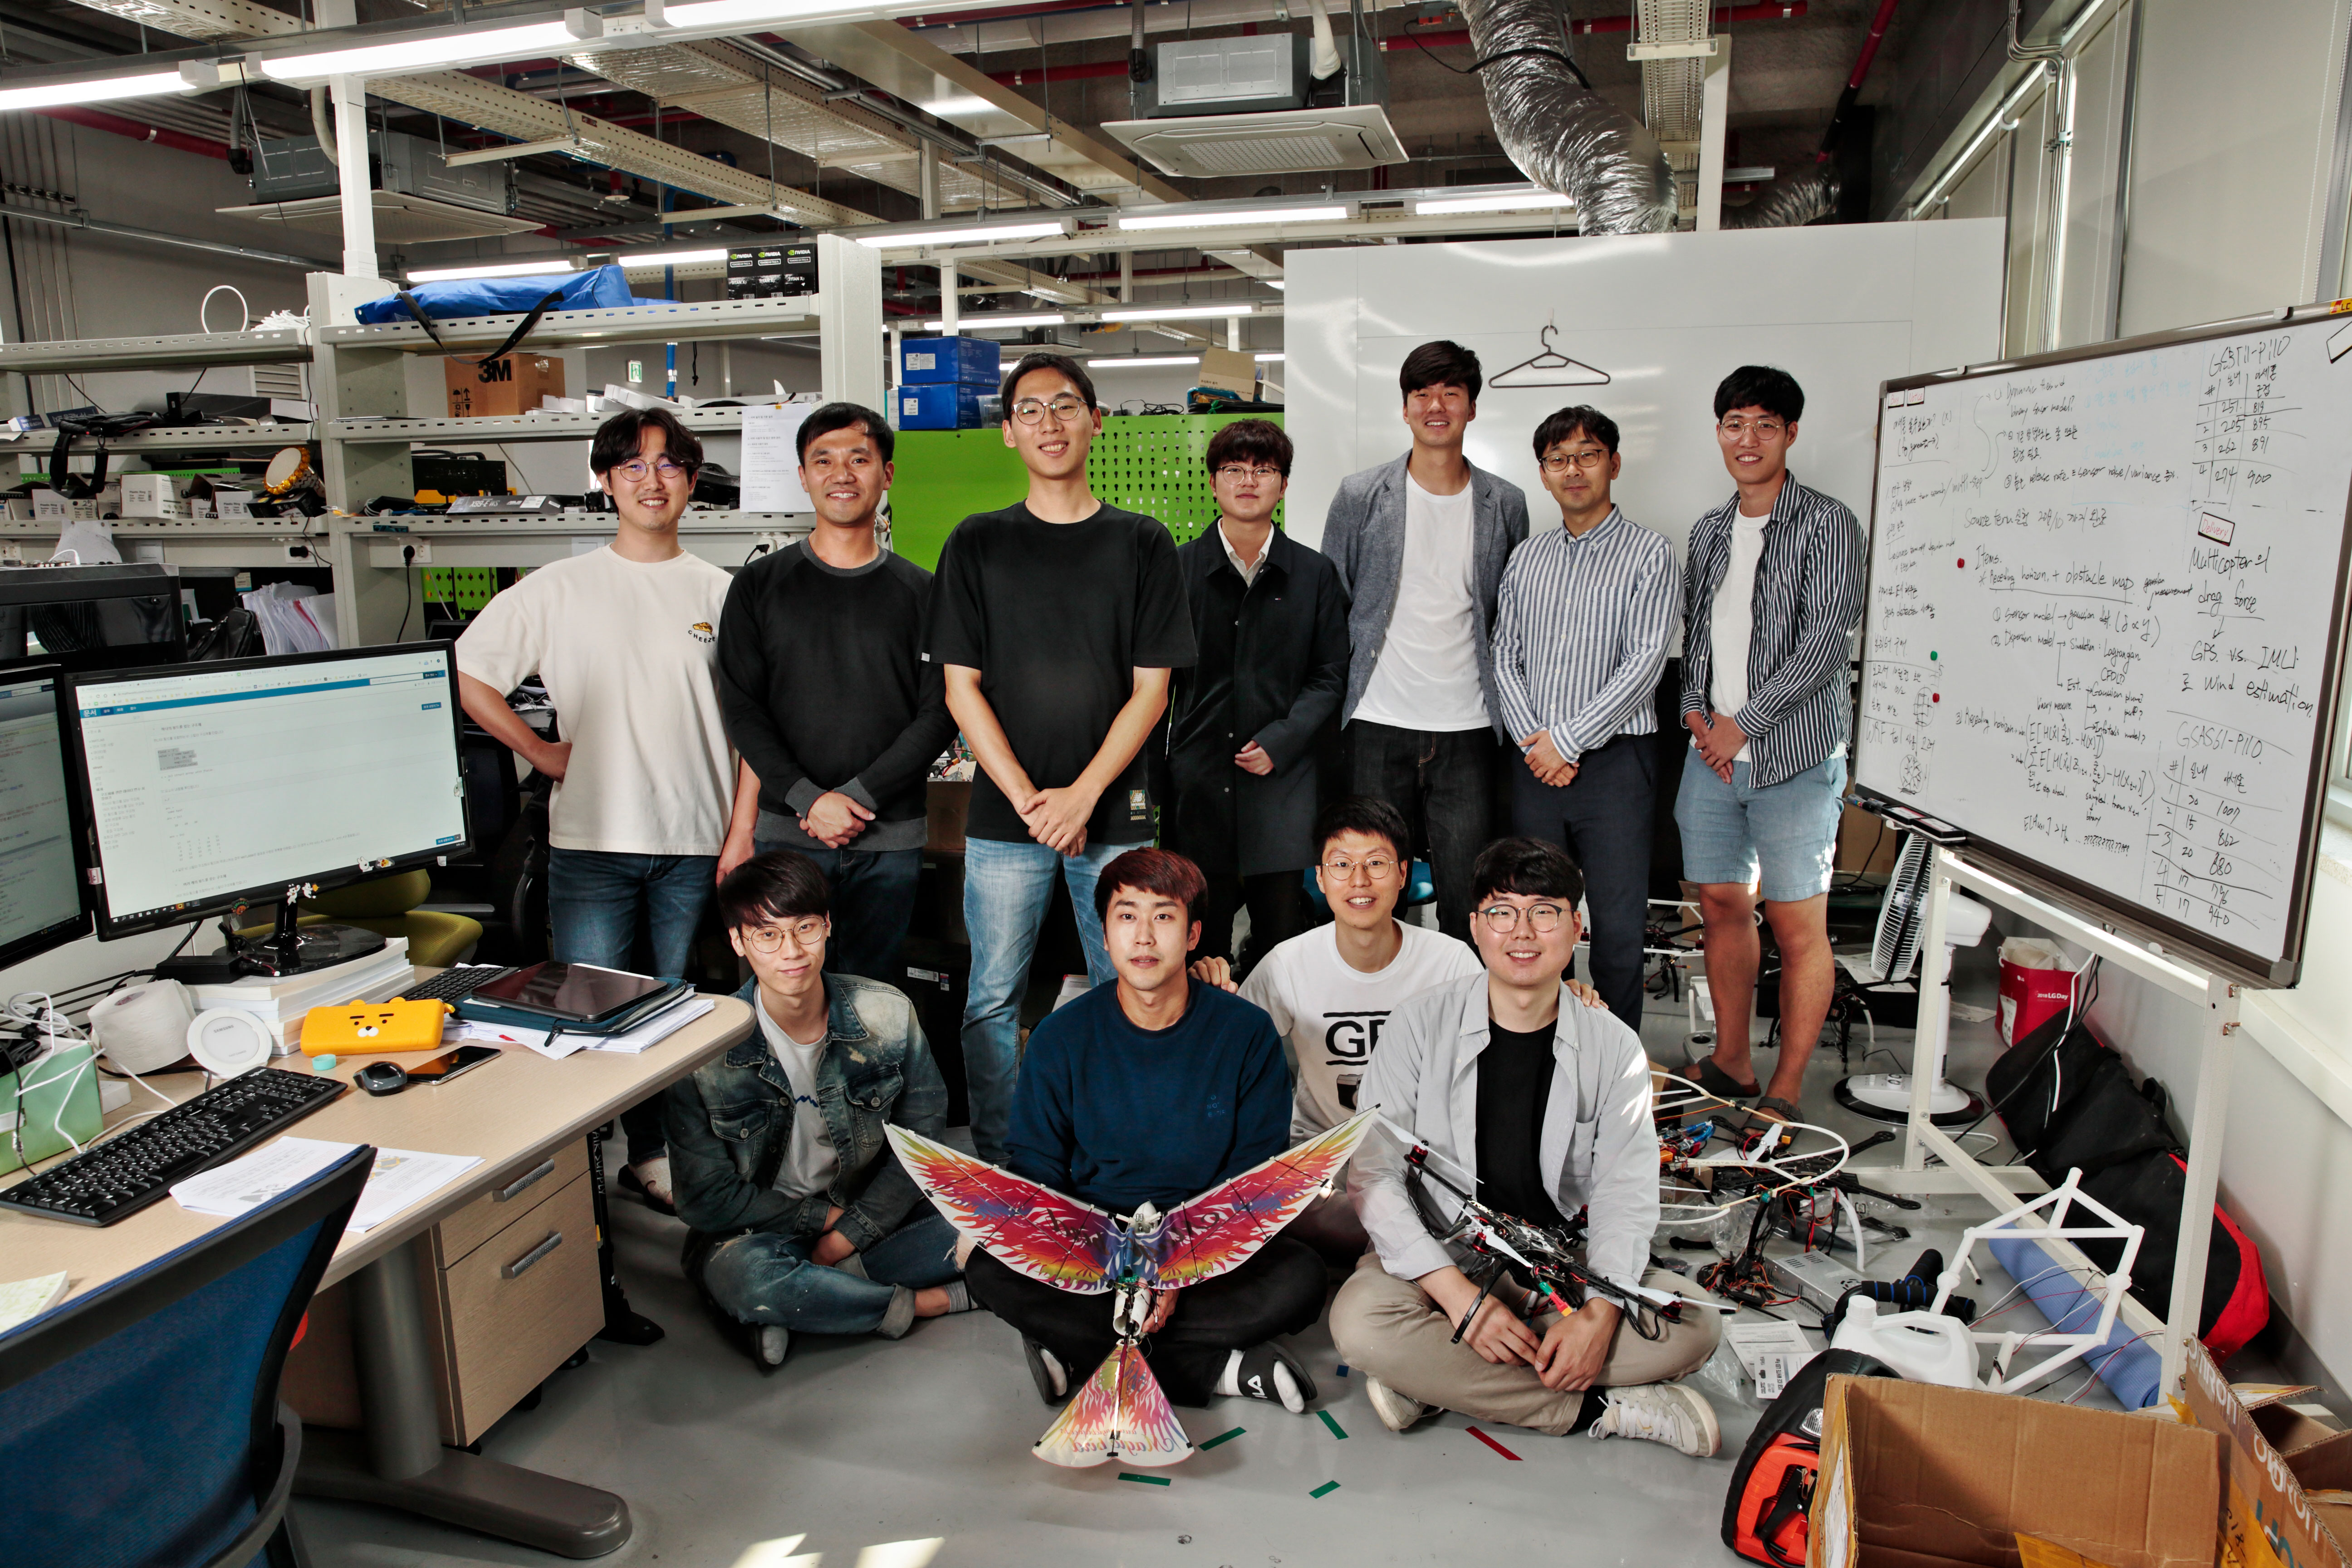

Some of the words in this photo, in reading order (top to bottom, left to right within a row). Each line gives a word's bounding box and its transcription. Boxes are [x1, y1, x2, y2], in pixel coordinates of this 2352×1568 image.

[478, 359, 512, 383] 3M
[1964, 508, 1992, 529] Source
[2201, 518, 2229, 540] Delivery
[2066, 560, 2107, 586] obstacle
[688, 630, 715, 643] CHEEZE
[83, 709, 97, 717] 문서
[214, 1024, 234, 1033] SAMSUNG
